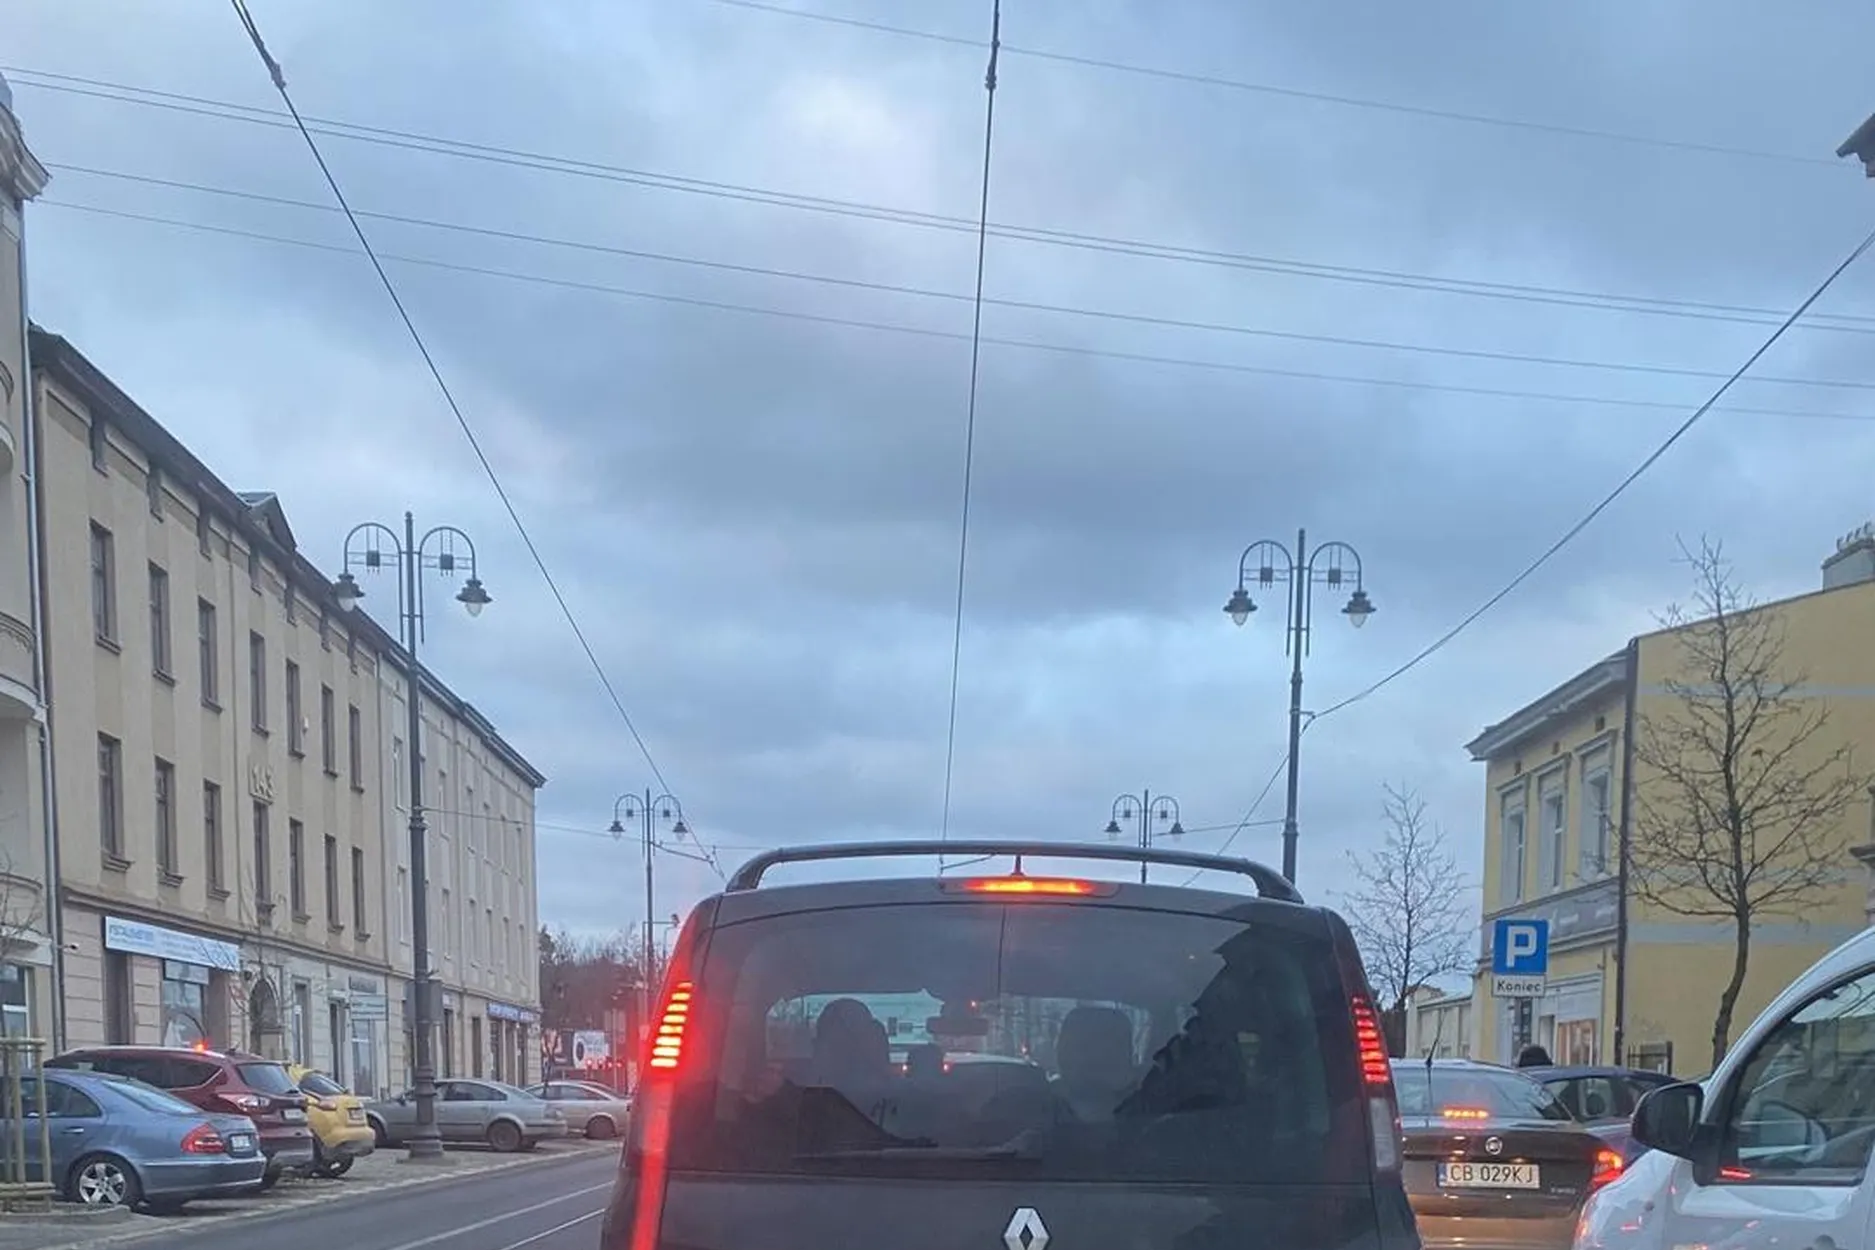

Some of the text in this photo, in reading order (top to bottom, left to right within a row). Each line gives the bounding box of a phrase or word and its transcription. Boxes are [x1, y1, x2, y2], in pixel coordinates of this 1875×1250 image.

[1506, 925, 1538, 969] P
[1497, 980, 1541, 993] Koniec
[1450, 1165, 1473, 1181] CB
